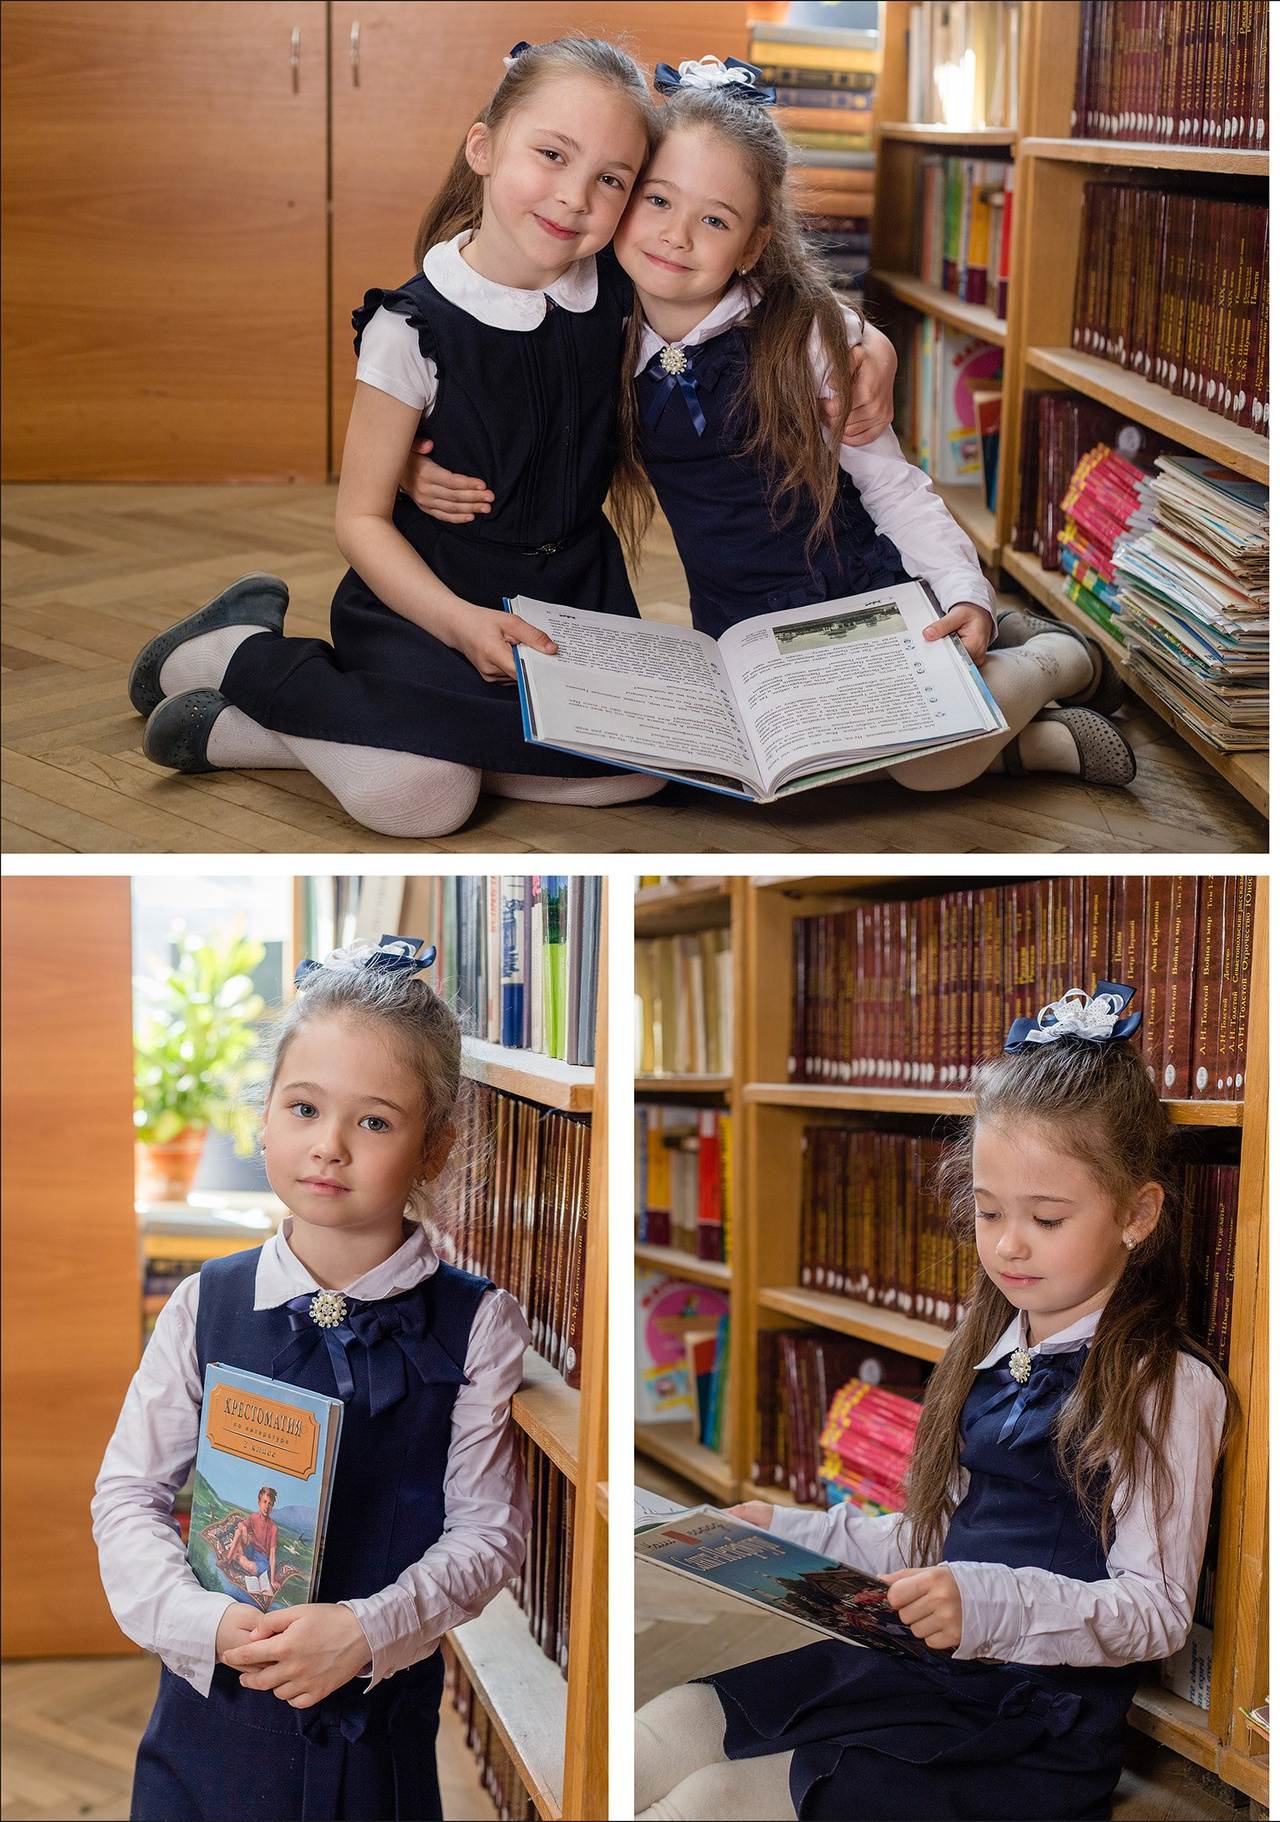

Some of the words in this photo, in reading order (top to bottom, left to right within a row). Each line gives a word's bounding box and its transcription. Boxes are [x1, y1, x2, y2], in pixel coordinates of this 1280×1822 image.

[1152, 901, 1160, 945] Каренина
[1232, 913, 1243, 983] Севастопольские
[1242, 912, 1251, 970] Отрочество
[1127, 957, 1135, 979] Петр
[1150, 948, 1158, 973] Анна
[1172, 945, 1180, 975] Война
[1203, 945, 1211, 975] Война
[1223, 948, 1231, 980] Детство
[1148, 988, 1156, 1026] Толстой
[1169, 984, 1178, 1024] Толстой
[1201, 985, 1209, 1025] Толстой
[1220, 998, 1228, 1030] Толстой
[1230, 991, 1238, 1026] Толстой
[1239, 978, 1248, 1019] Толстой
[1200, 1028, 1207, 1040] Н.
[1218, 1203, 1226, 1236] делать?
[1214, 1238, 1223, 1255] Что
[572, 1235, 584, 1302] Достоевский
[1208, 1272, 1220, 1336] Чернышевский
[1220, 1297, 1231, 1335] Шмелев
[224, 1397, 302, 1437] ХРЕСТОМАТИЯ
[246, 1426, 289, 1444] литературе
[251, 1445, 276, 1458] класс
